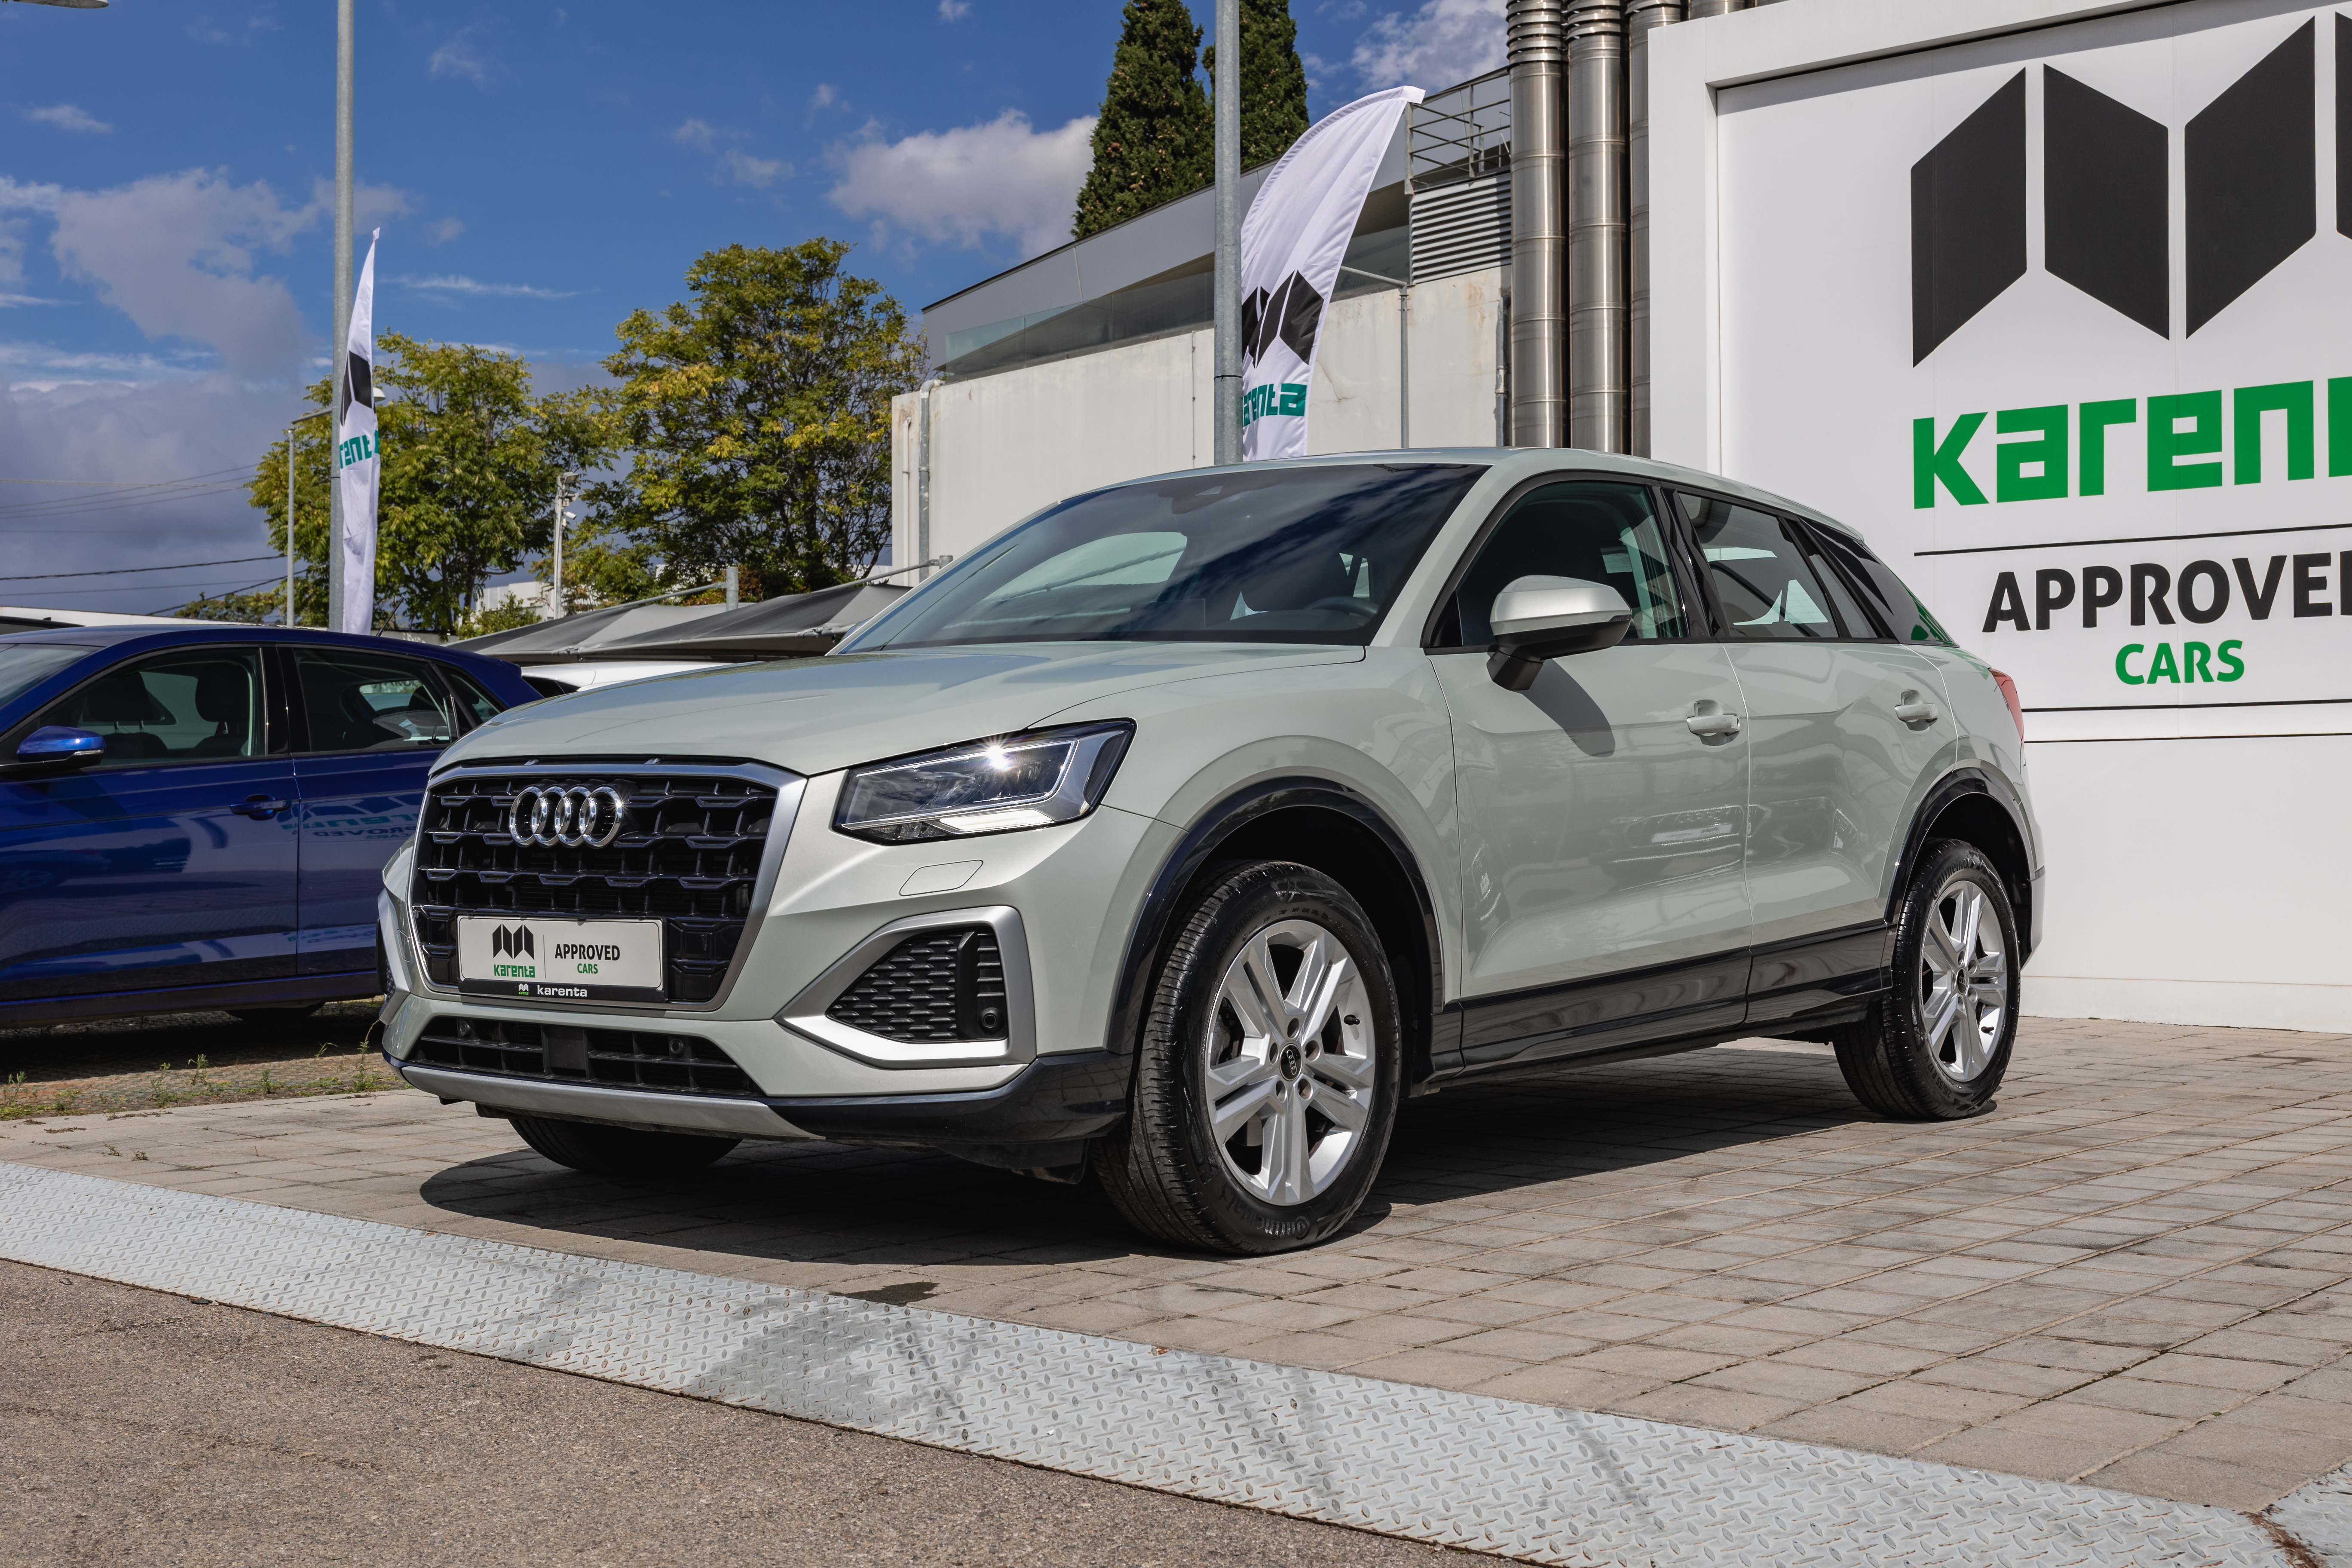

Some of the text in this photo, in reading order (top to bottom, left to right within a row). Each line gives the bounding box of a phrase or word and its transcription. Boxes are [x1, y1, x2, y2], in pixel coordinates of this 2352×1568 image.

[1243, 383, 1307, 427] arenta
[2115, 640, 2245, 685] CARS
[554, 943, 620, 961] APPROVED
[577, 963, 598, 974] CARS
[537, 985, 587, 997] karenta
[1225, 1194, 1311, 1241] Continental
